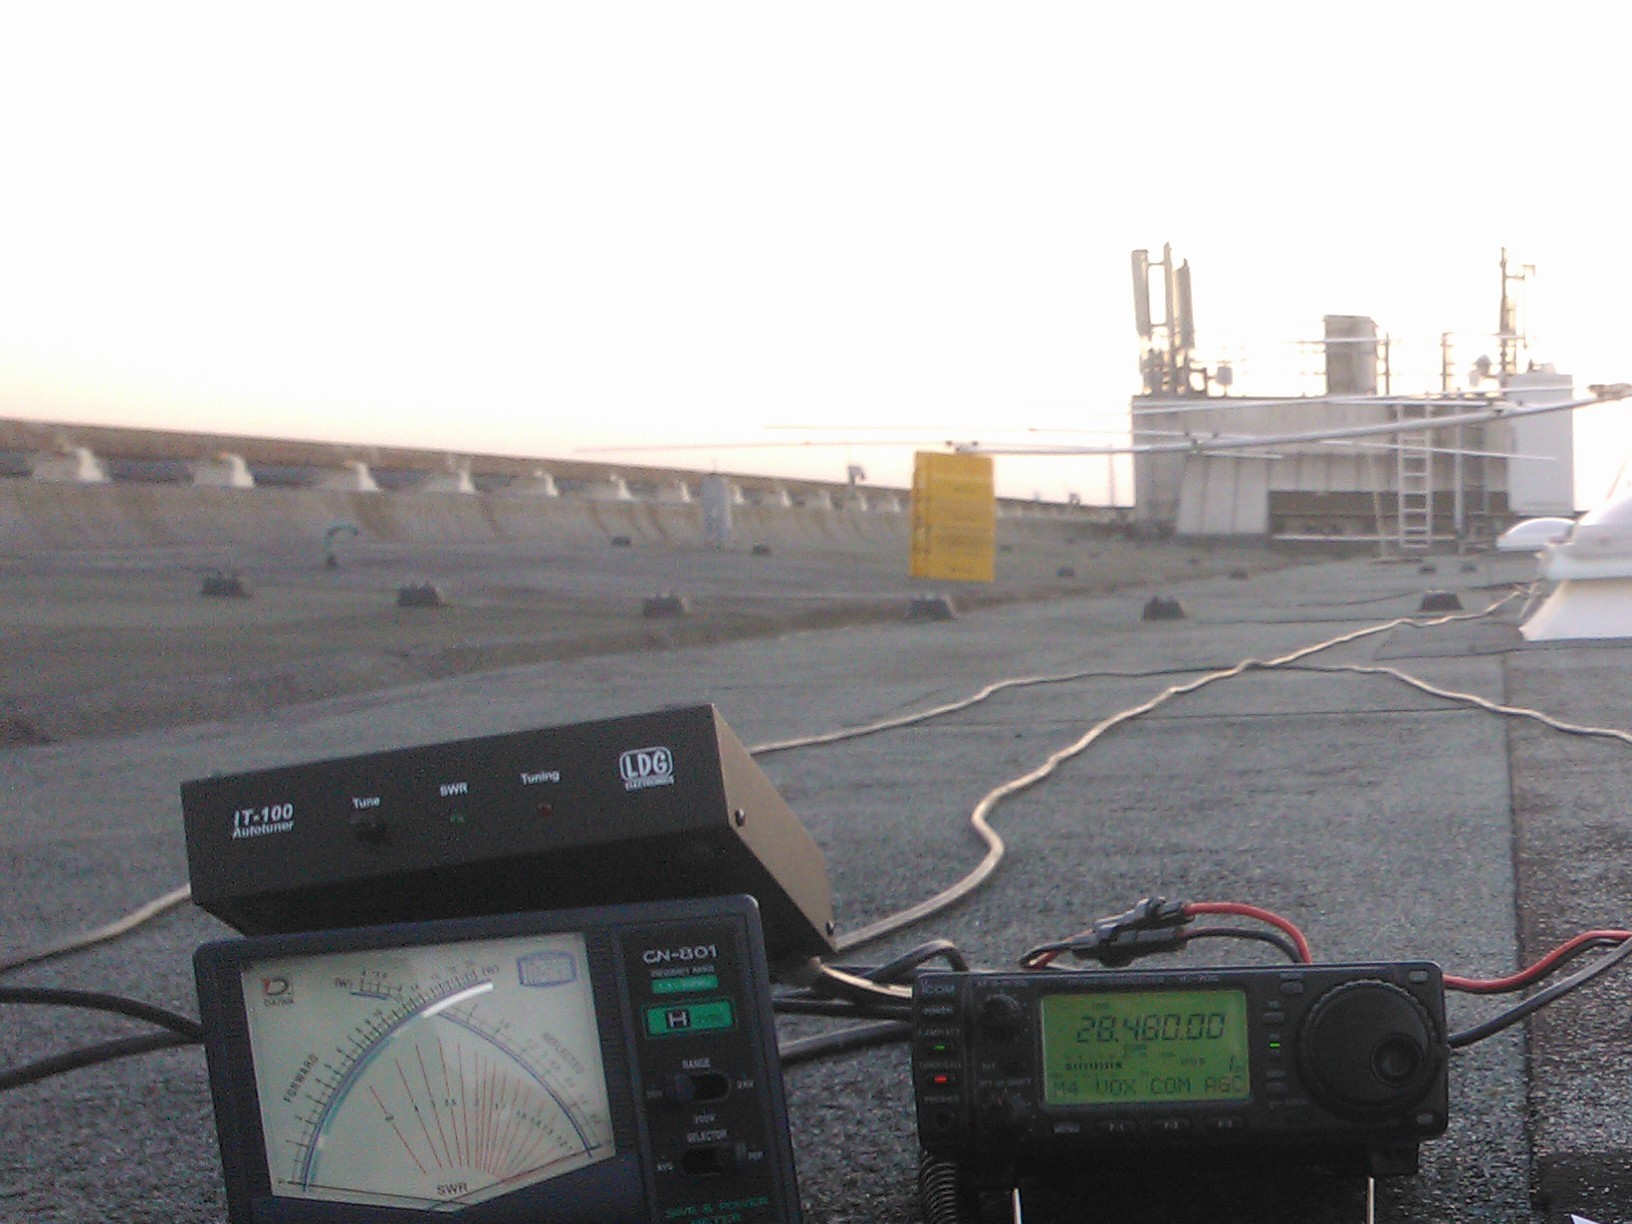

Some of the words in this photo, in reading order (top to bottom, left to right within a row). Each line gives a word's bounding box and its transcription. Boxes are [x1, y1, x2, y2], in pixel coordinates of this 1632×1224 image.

[624, 751, 669, 779] LDG
[520, 771, 560, 785] Tuning
[440, 782, 468, 797] SWR
[352, 797, 381, 810] Tune
[233, 803, 293, 828] IT-100
[232, 819, 294, 839] Autotuner
[643, 944, 717, 964] CN-801
[667, 1011, 688, 1028] H
[282, 1053, 319, 1103] FORWARD
[1150, 1077, 1191, 1095] COM
[1204, 1075, 1245, 1093] AGC
[1095, 1079, 1136, 1096] VOX
[437, 1182, 468, 1197] SWR
